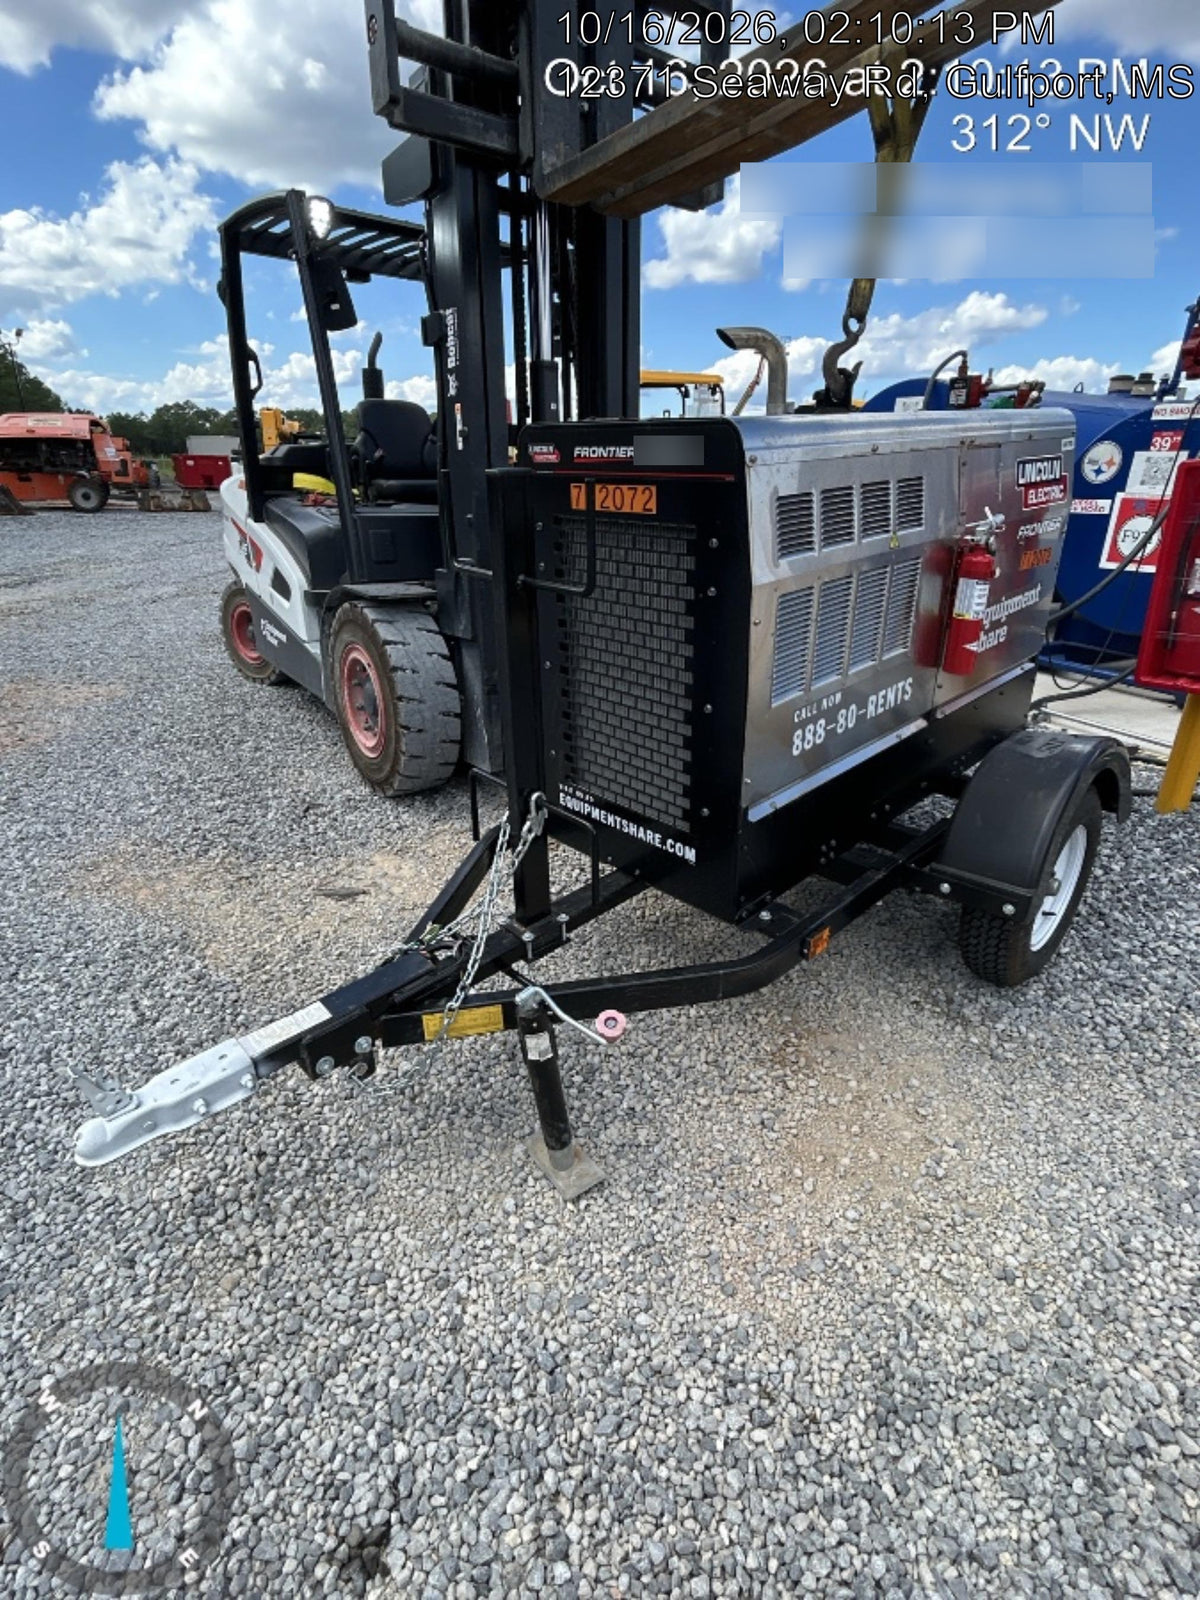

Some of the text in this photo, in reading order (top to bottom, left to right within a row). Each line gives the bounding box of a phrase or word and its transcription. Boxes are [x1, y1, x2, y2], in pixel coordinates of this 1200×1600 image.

[573, 446, 634, 458] FRONTIER
[1018, 459, 1061, 484] LINCOLN
[572, 485, 654, 513] 7 2072
[1027, 485, 1064, 504] ELECTRIC
[982, 582, 1041, 629] quipment
[979, 625, 1008, 652] hare
[791, 676, 913, 757] 888-80-RENTS
[794, 691, 842, 723] CALL NOW
[559, 793, 696, 863] EQUIPMENTSHARE.COM
